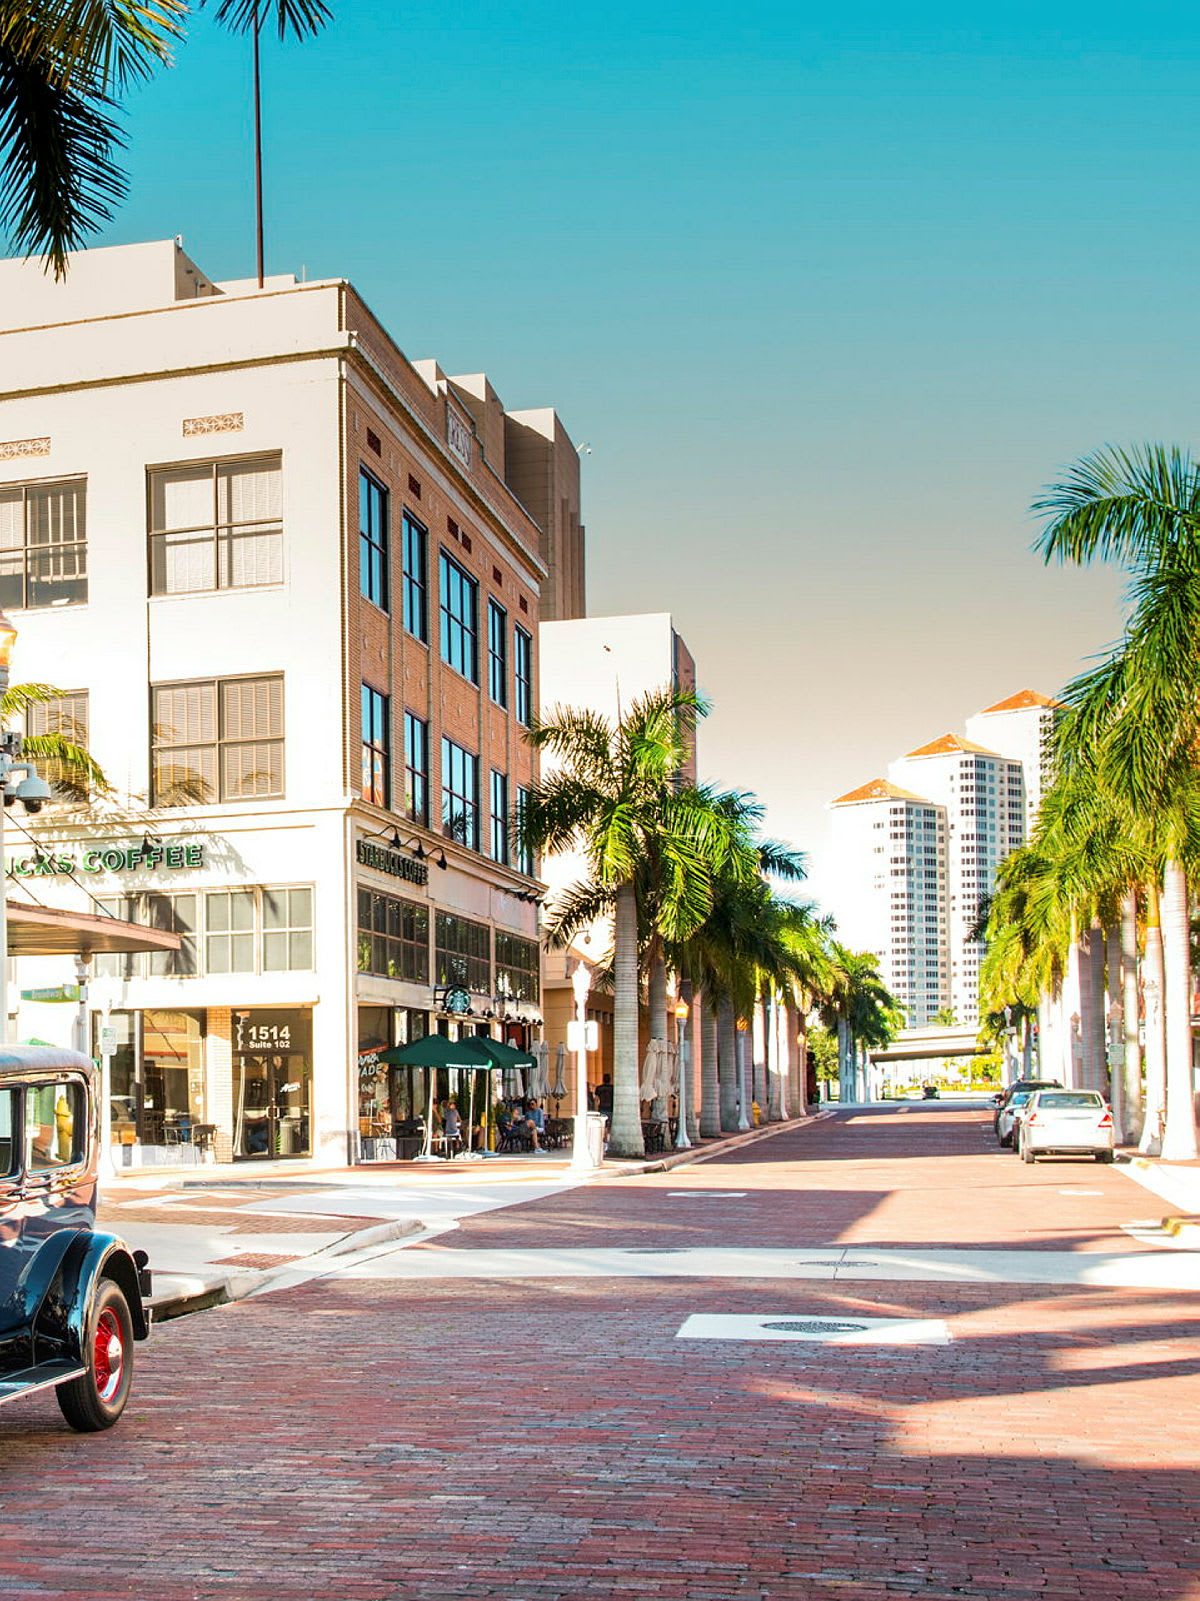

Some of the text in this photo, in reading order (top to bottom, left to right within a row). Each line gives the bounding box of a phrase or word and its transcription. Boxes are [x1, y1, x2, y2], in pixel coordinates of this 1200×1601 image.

[83, 844, 203, 873] COFFEE
[249, 1025, 291, 1040] 1514
[249, 1040, 291, 1049] Suite 102
